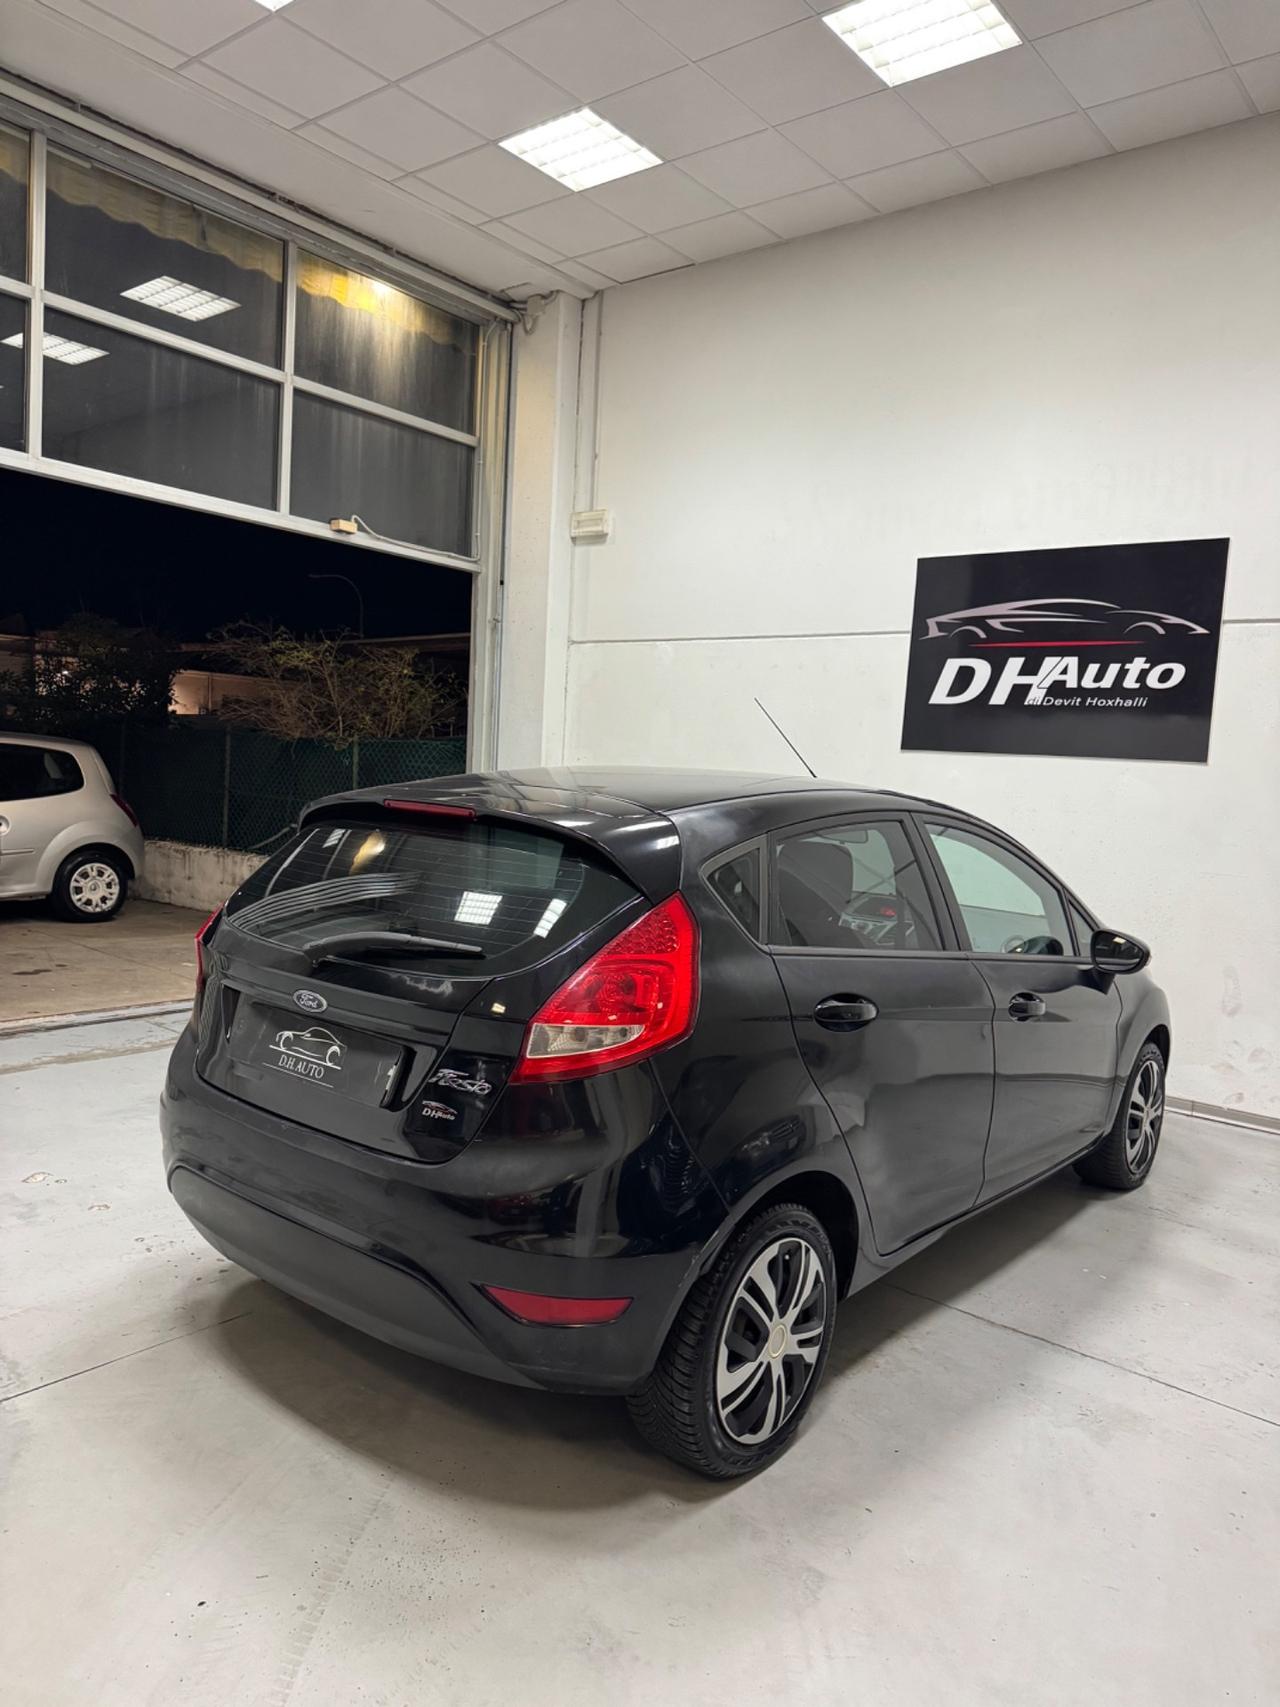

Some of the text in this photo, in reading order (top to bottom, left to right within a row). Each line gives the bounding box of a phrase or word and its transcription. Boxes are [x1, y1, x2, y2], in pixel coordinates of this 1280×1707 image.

[1043, 696, 1082, 706] Devit
[1085, 696, 1149, 707] Hoxhalli
[299, 993, 318, 1009] Ford
